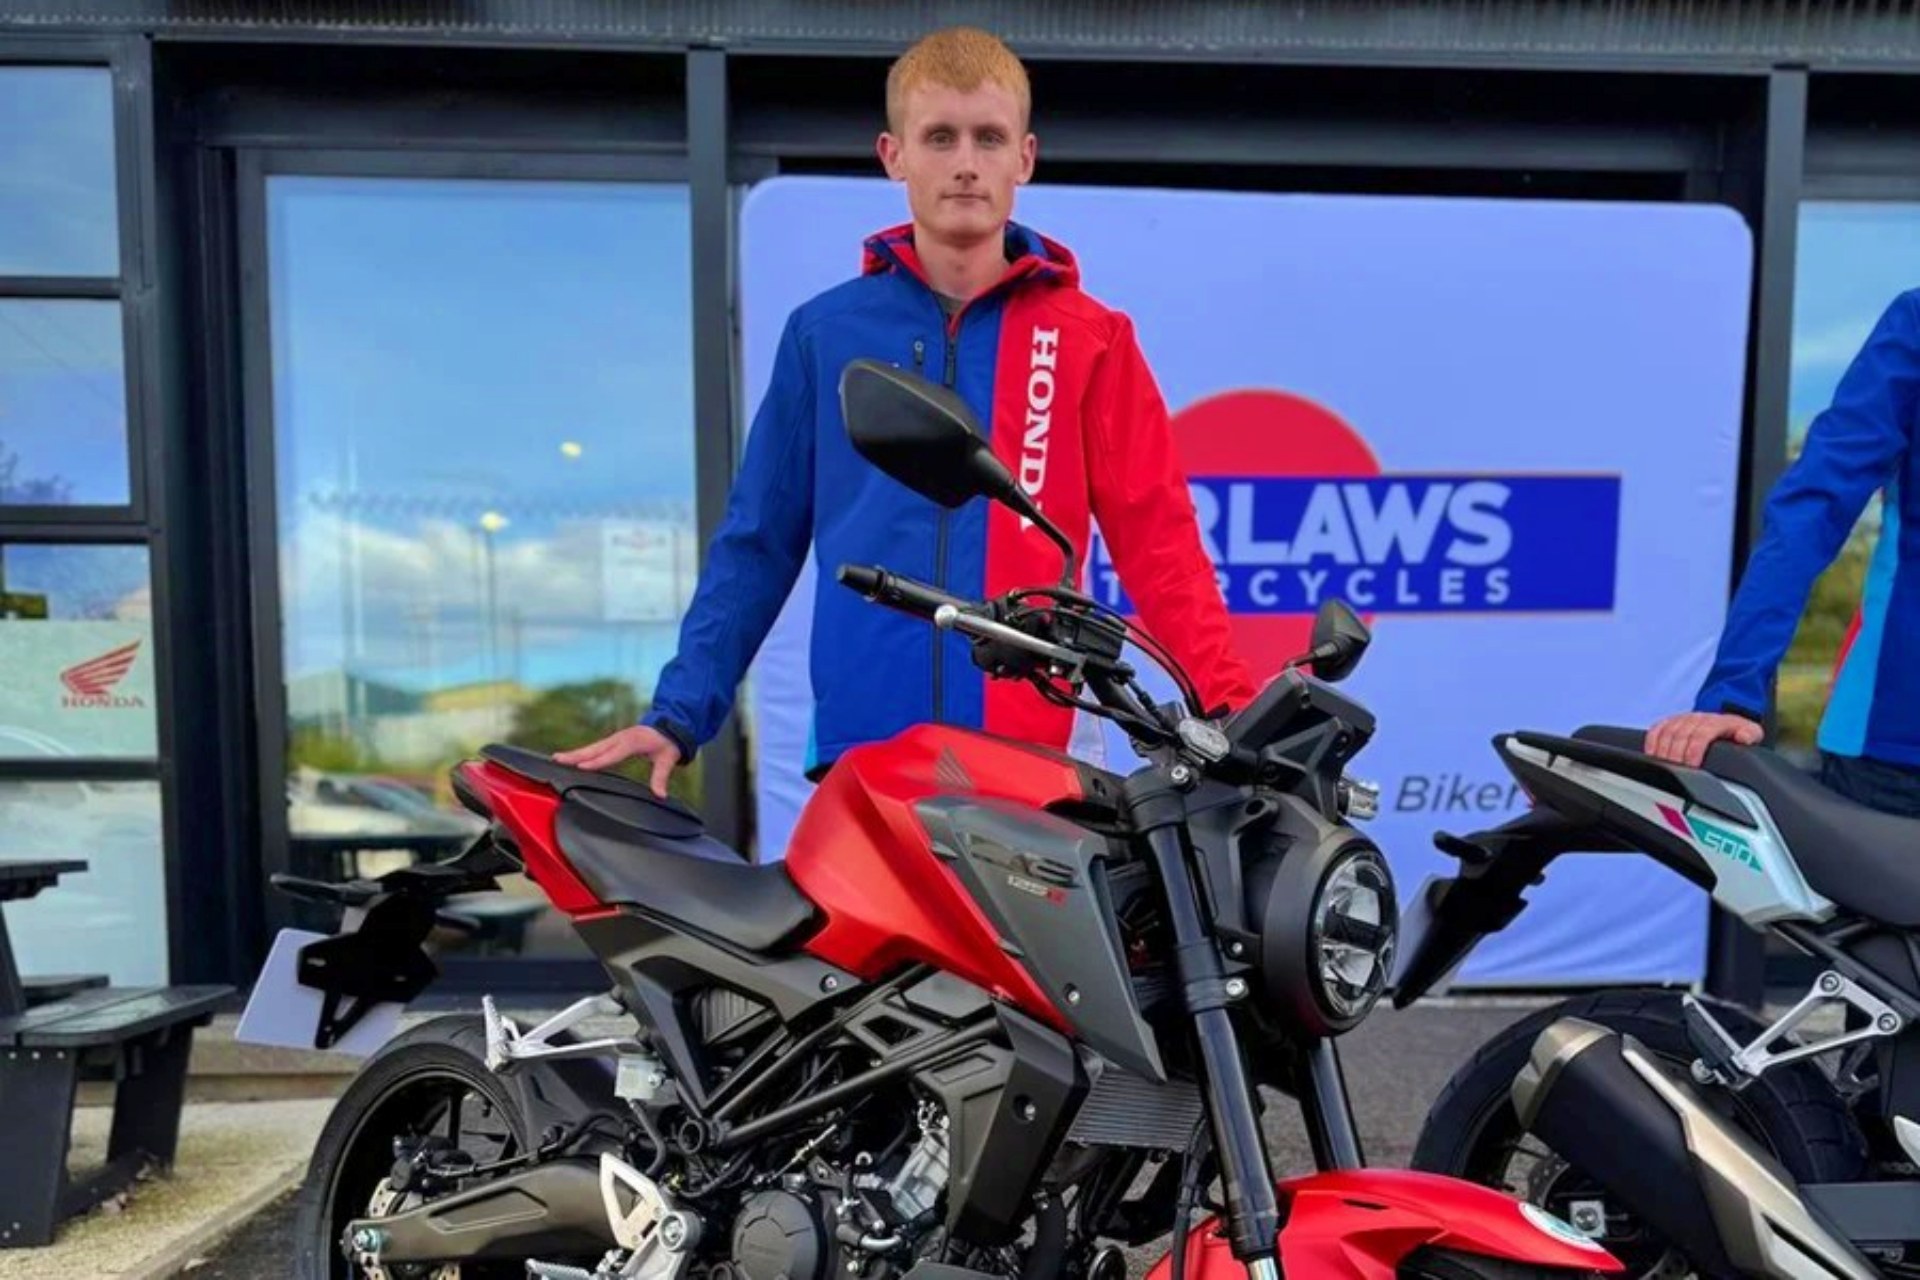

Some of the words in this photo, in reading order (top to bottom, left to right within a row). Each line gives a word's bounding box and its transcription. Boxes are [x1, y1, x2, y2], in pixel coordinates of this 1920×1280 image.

[1098, 480, 1513, 566] RLAWS
[61, 694, 145, 709] HONDA
[1703, 830, 1752, 865] 500
